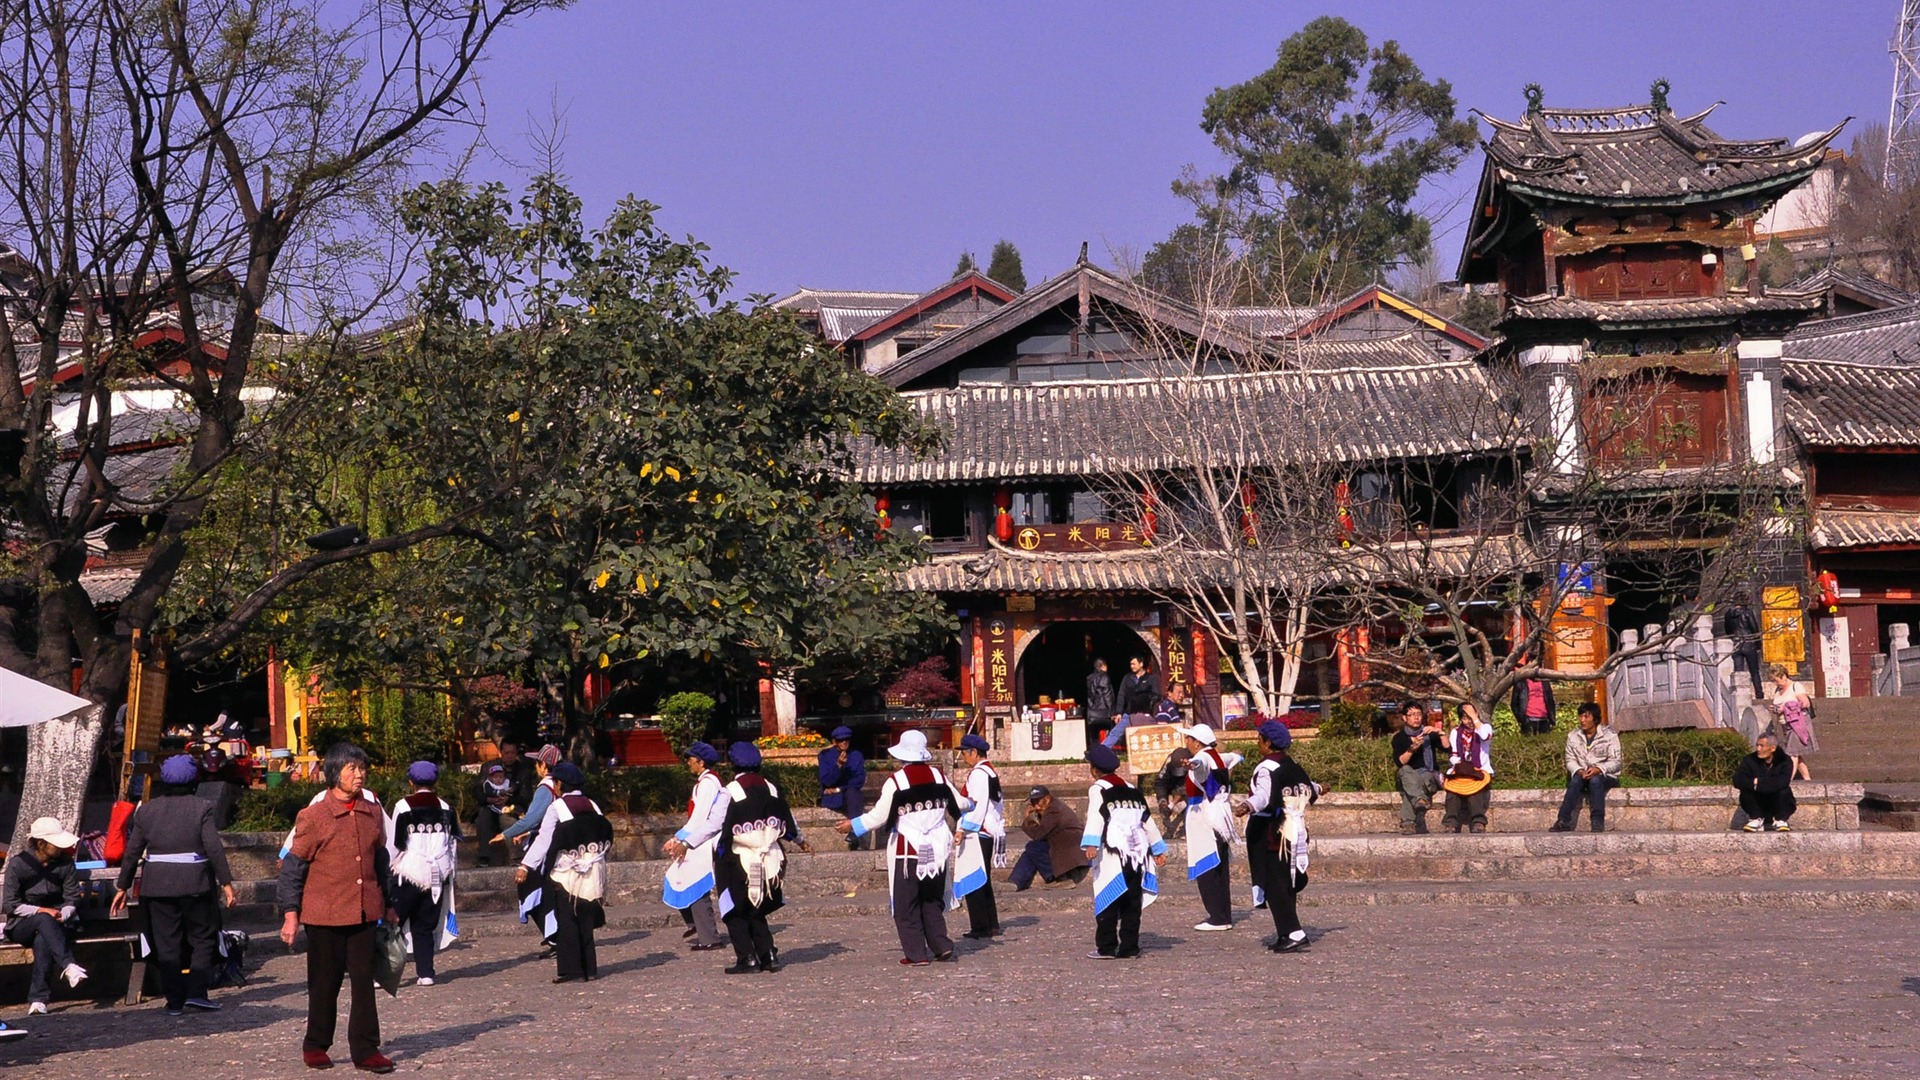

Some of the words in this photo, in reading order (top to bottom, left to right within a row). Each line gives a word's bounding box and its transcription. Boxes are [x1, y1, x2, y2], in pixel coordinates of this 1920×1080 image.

[1043, 525, 1137, 542] 一米阳光
[991, 639, 1008, 693] 一米阳光
[987, 692, 1014, 702] 三分店
